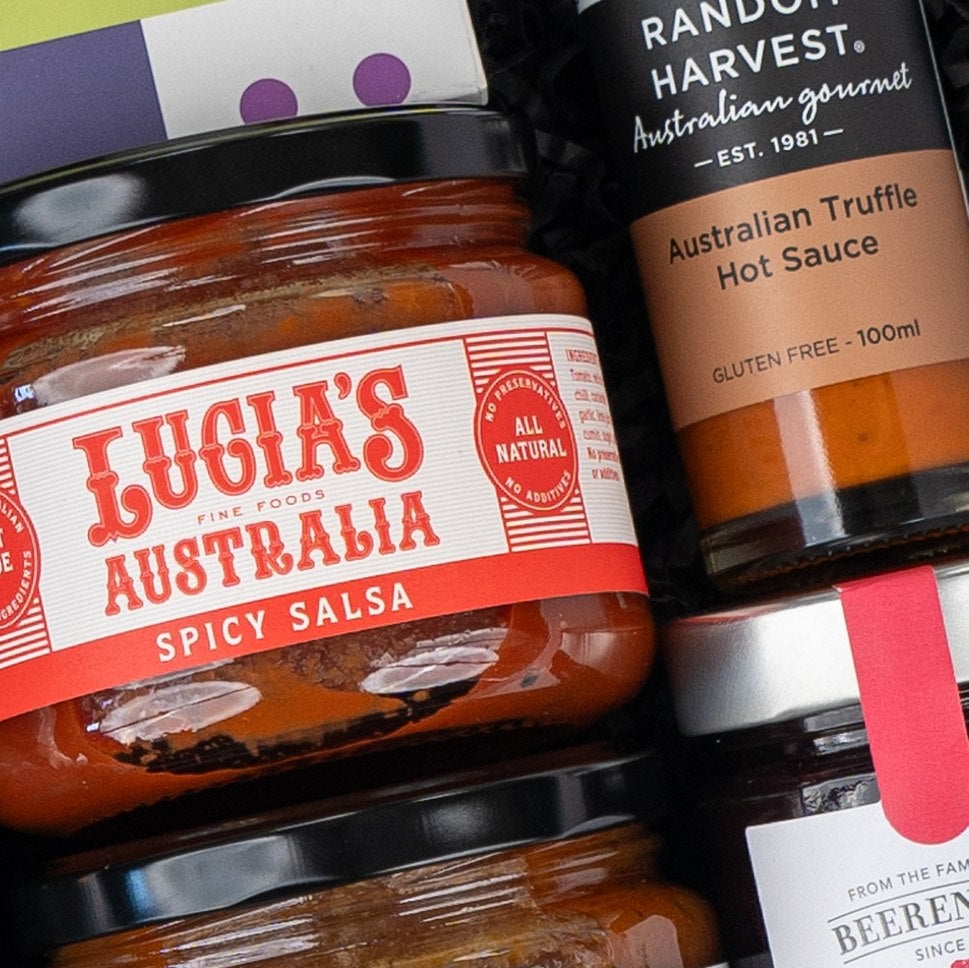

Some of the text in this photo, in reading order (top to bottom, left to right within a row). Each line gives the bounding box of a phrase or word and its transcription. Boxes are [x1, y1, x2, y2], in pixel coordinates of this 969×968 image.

[641, 0, 840, 50] RAND
[633, 62, 912, 153] Australian gourmet
[771, 129, 819, 154] 1981
[668, 183, 919, 264] Australian Truffle
[717, 234, 880, 290] Hot Sauce
[712, 351, 781, 384] GLUTEN
[786, 337, 839, 364] FREE
[857, 319, 921, 347] 100ml
[494, 377, 568, 430] PRESERVATIVES
[514, 415, 543, 436] ALL
[72, 364, 425, 547] LUCIA'S
[495, 438, 568, 464] NATURAL
[197, 488, 326, 525] FINE FOODS
[526, 470, 572, 504] ADDITIVES
[104, 490, 441, 617] AUSTRALIA
[156, 582, 414, 662] SPICY SALSA
[847, 877, 893, 902] FROM
[897, 867, 931, 886] THE
[915, 938, 966, 962] SINCE
